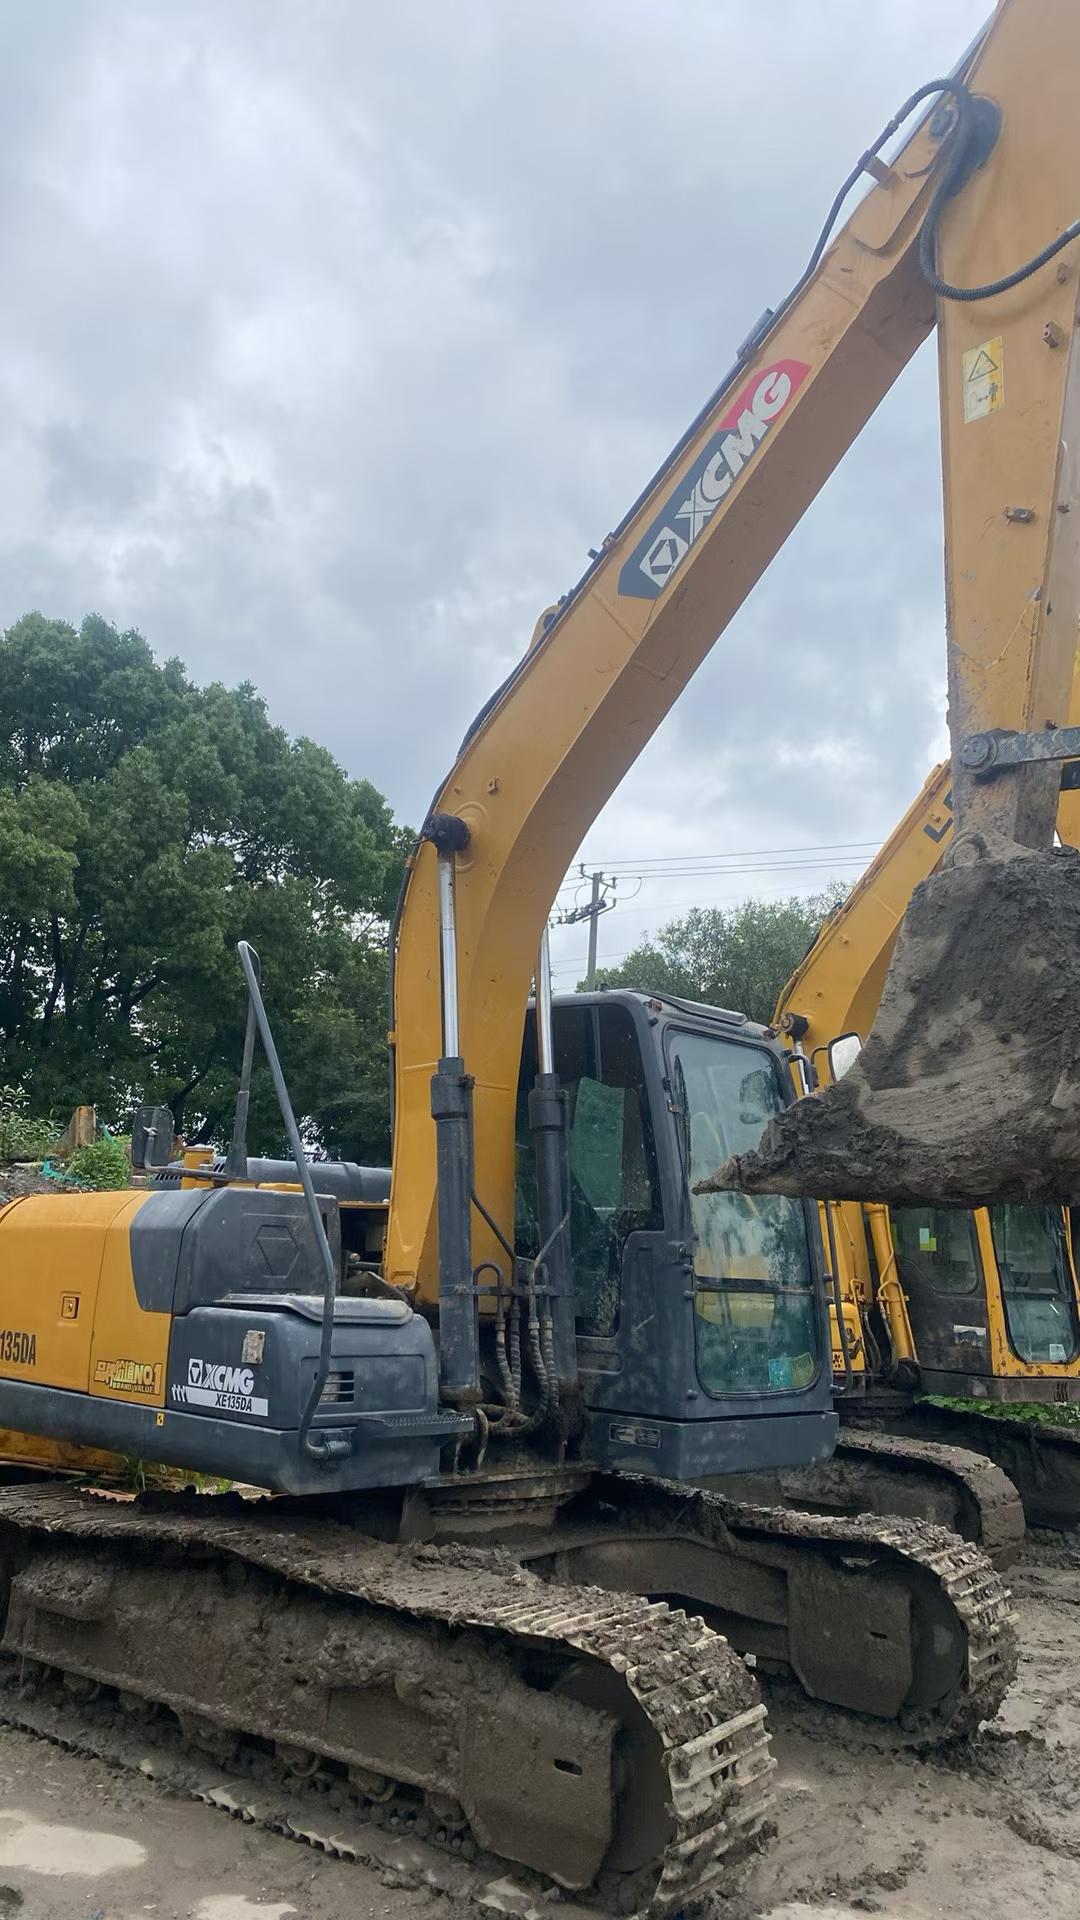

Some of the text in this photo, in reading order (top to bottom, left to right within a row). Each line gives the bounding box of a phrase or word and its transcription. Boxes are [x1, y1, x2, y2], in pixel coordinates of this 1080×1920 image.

[674, 371, 792, 547] XCMG
[0, 1329, 36, 1366] 135DA
[201, 1363, 255, 1395] XCMG
[215, 1393, 252, 1412] XE135DA
